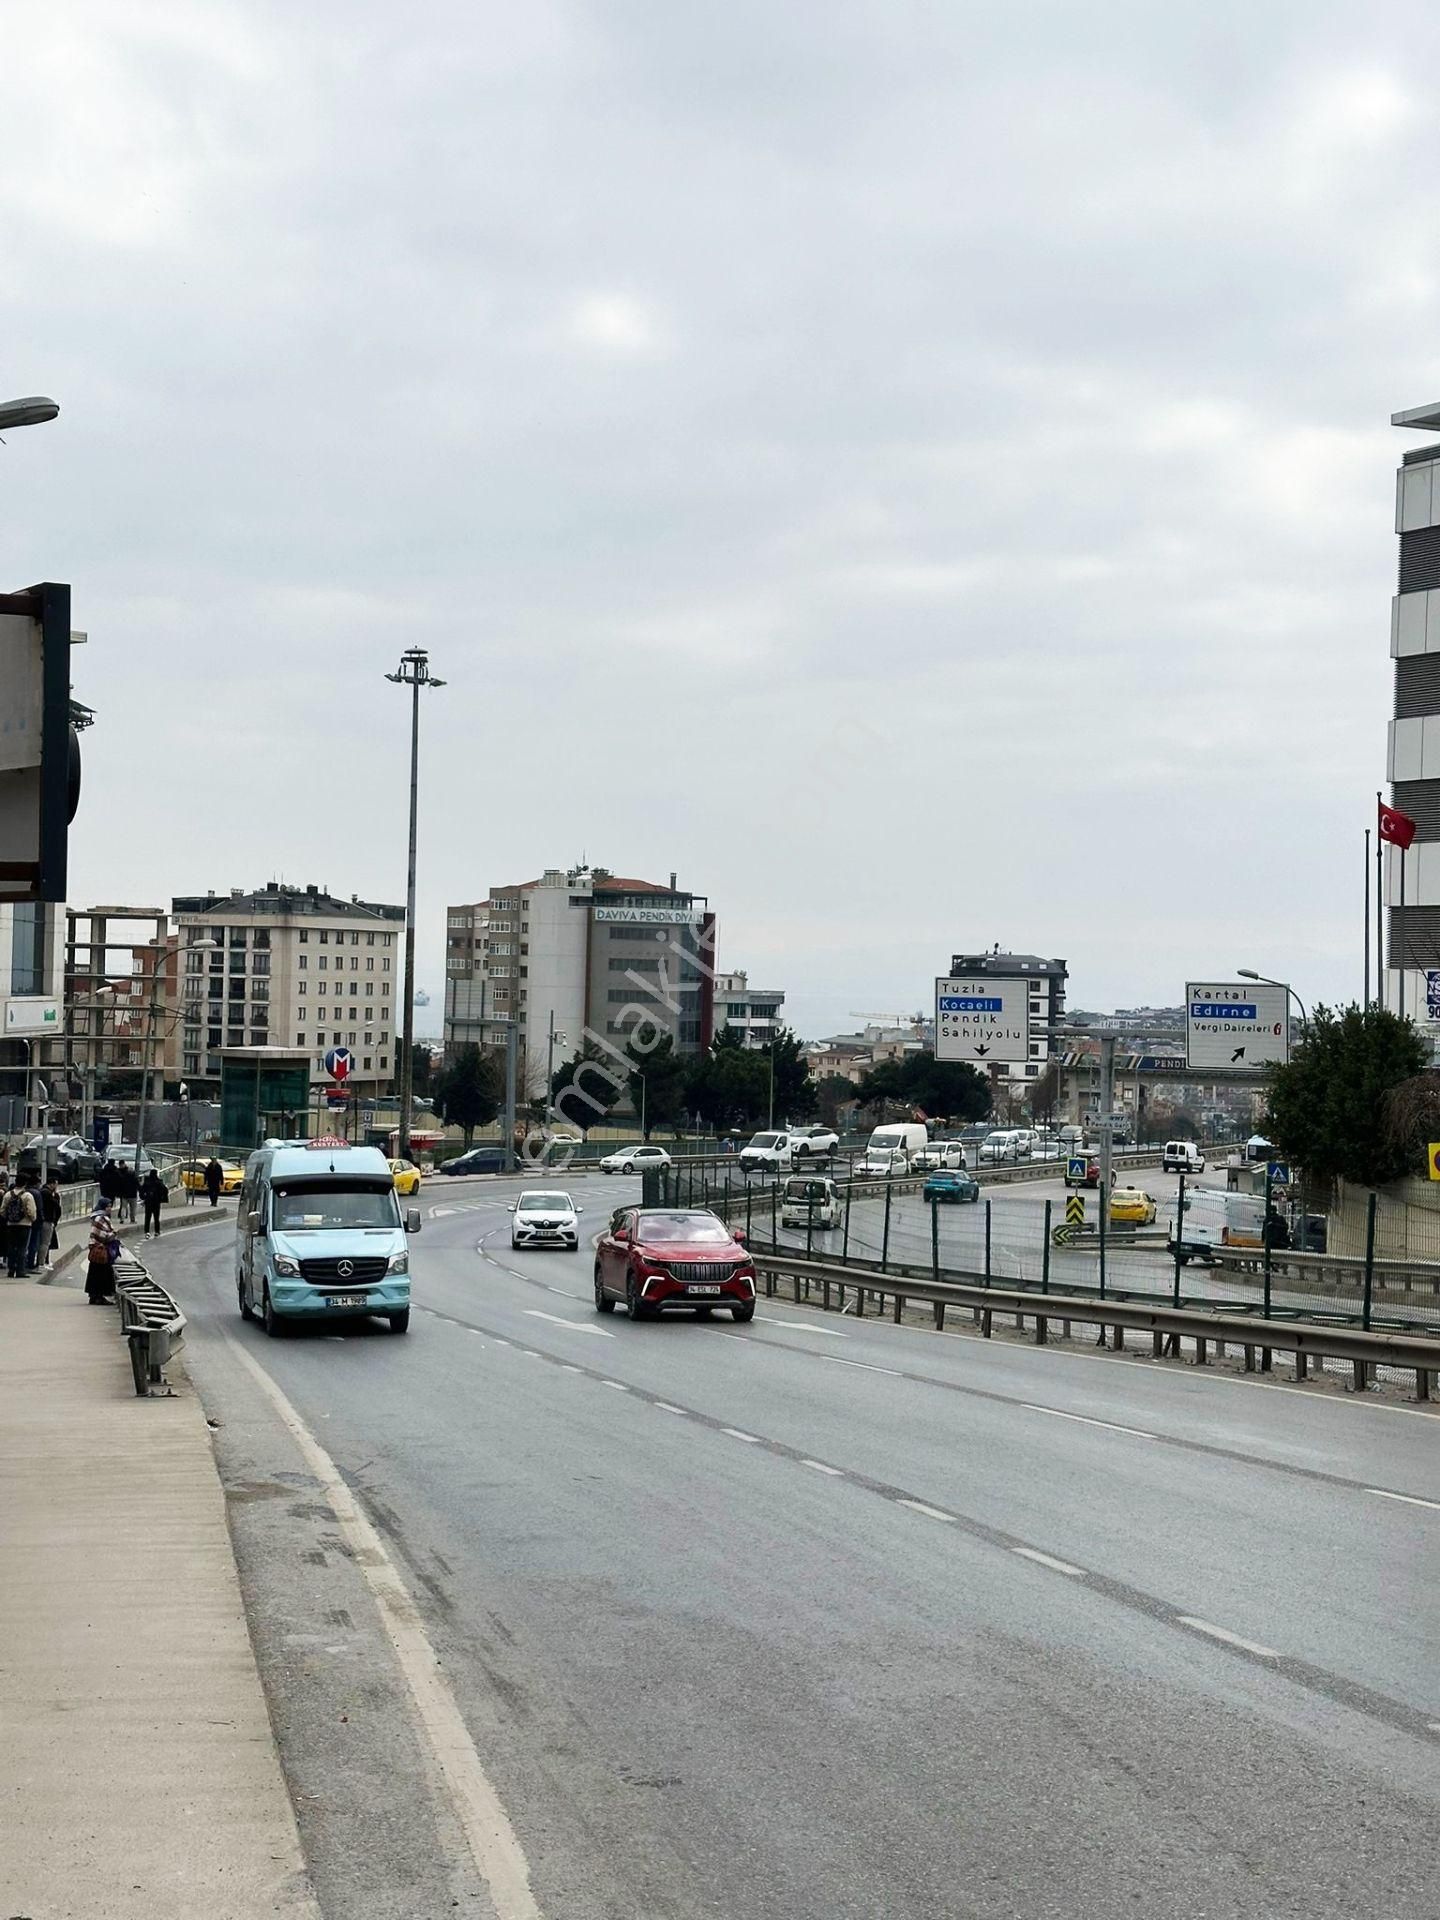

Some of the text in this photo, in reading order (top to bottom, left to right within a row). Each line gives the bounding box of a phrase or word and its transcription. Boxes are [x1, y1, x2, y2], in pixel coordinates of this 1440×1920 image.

[942, 983, 985, 993] Tuzla
[1193, 989, 1247, 1000] Kartal
[941, 999, 993, 1010] Kocaeli
[1193, 1005, 1250, 1017] Edirne
[942, 1013, 997, 1023] Pendik
[942, 1027, 1020, 1040] Sahilyolu
[1194, 1023, 1221, 1033] Vergi
